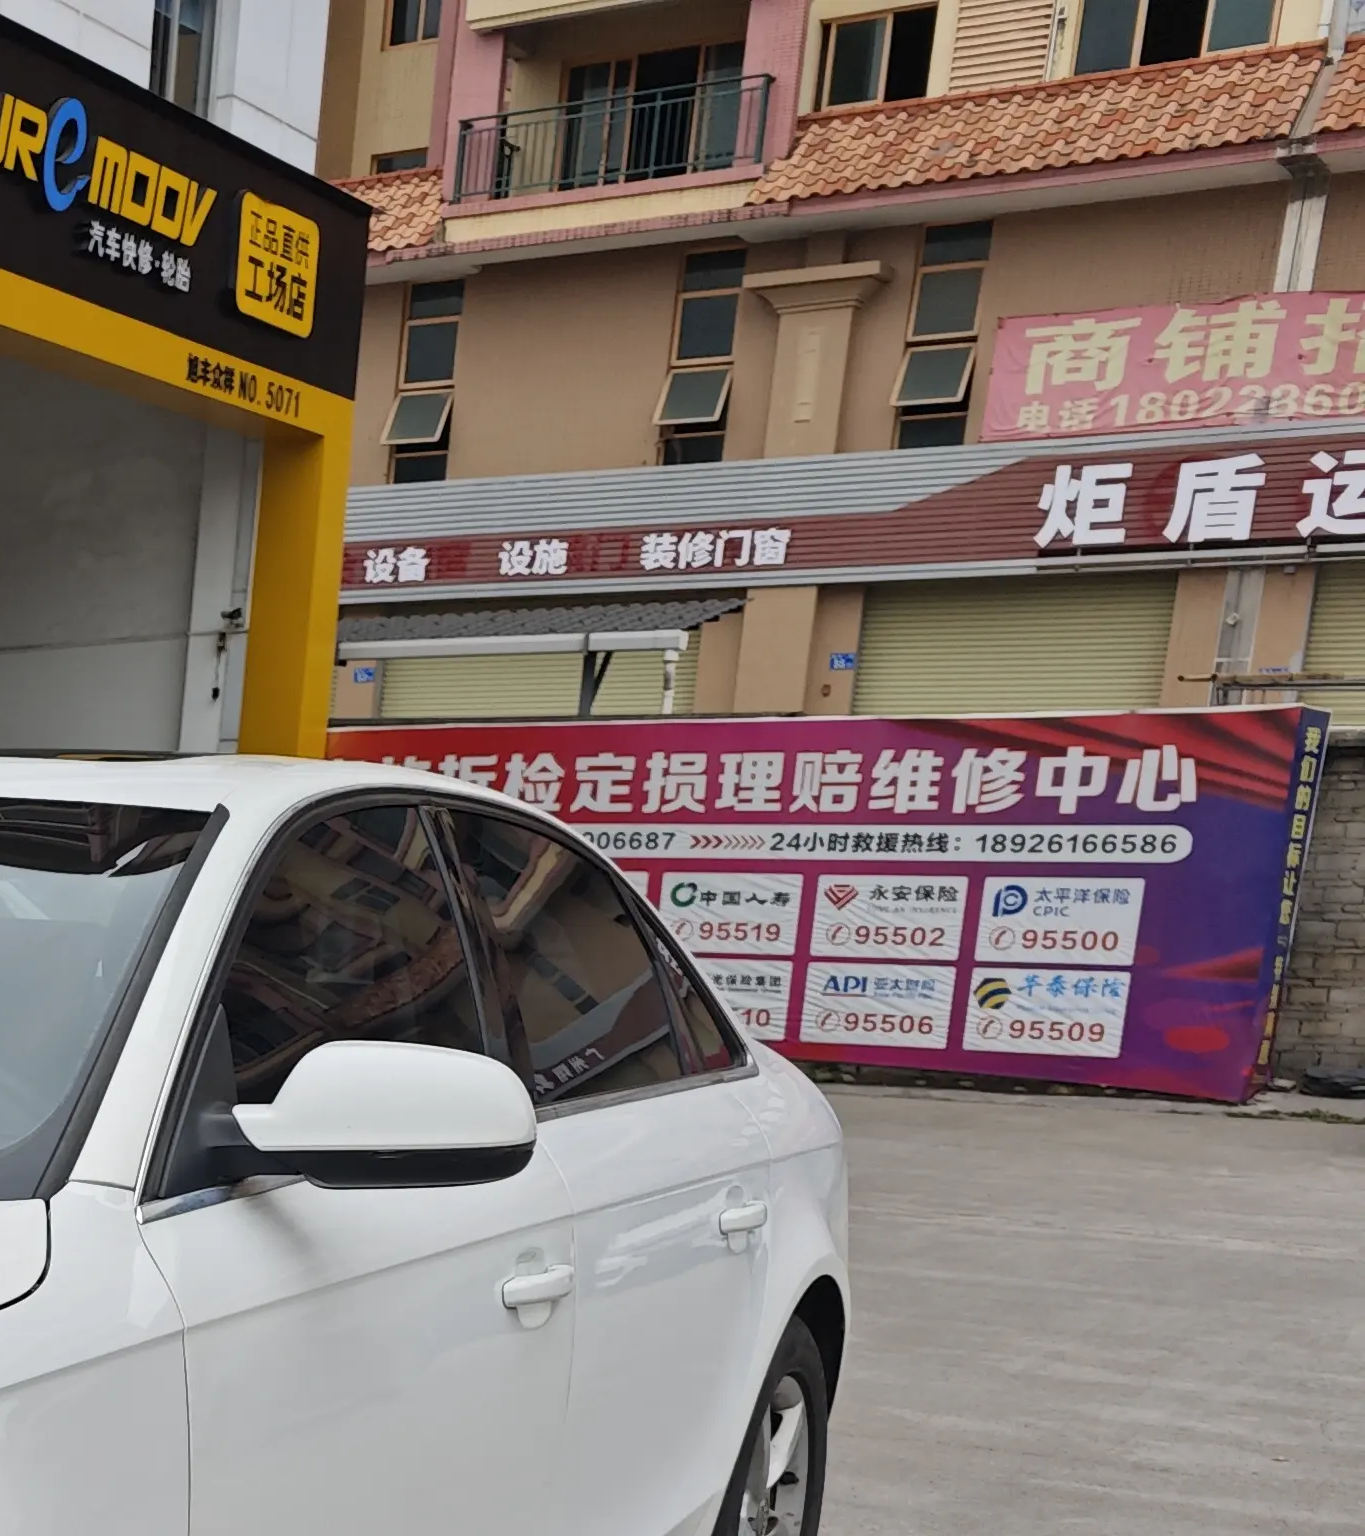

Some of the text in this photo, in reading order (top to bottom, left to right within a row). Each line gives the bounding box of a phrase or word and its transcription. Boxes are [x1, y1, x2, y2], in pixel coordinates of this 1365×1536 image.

[244, 255, 308, 321] 工场店
[363, 527, 792, 583] 设备 设施 装修门窗
[382, 744, 1197, 814] 检定损理赔维修中心
[699, 889, 791, 908] 中国人寿
[869, 884, 959, 902] 永安保险
[1034, 887, 1132, 905] 太平洋保险
[1033, 906, 1070, 917] CPIC
[699, 922, 781, 942] 95519
[855, 925, 946, 947] 95502
[1022, 929, 1119, 951] 95500
[822, 975, 868, 993] API
[844, 1012, 934, 1035] 95506
[1009, 1019, 1105, 1042] 95509
